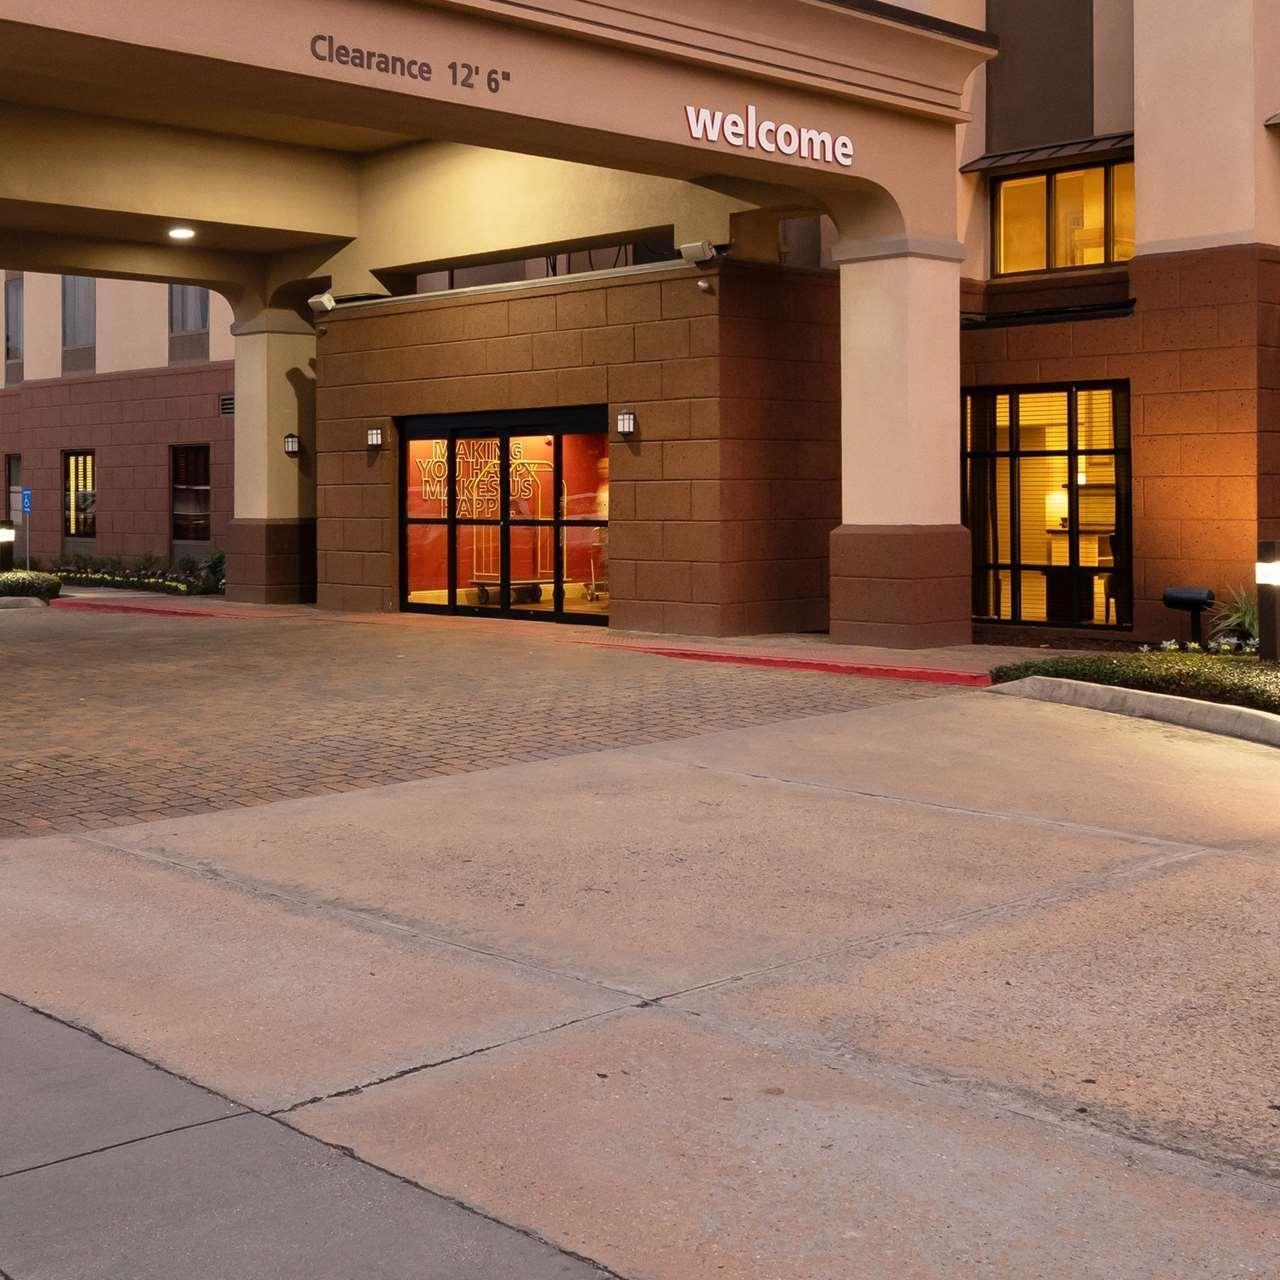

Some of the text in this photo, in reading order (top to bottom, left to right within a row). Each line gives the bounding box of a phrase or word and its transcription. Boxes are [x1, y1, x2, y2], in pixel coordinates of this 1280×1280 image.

[310, 34, 511, 94] Clearance 12' 6"
[685, 105, 854, 166] welcome
[470, 459, 538, 480] HAPY
